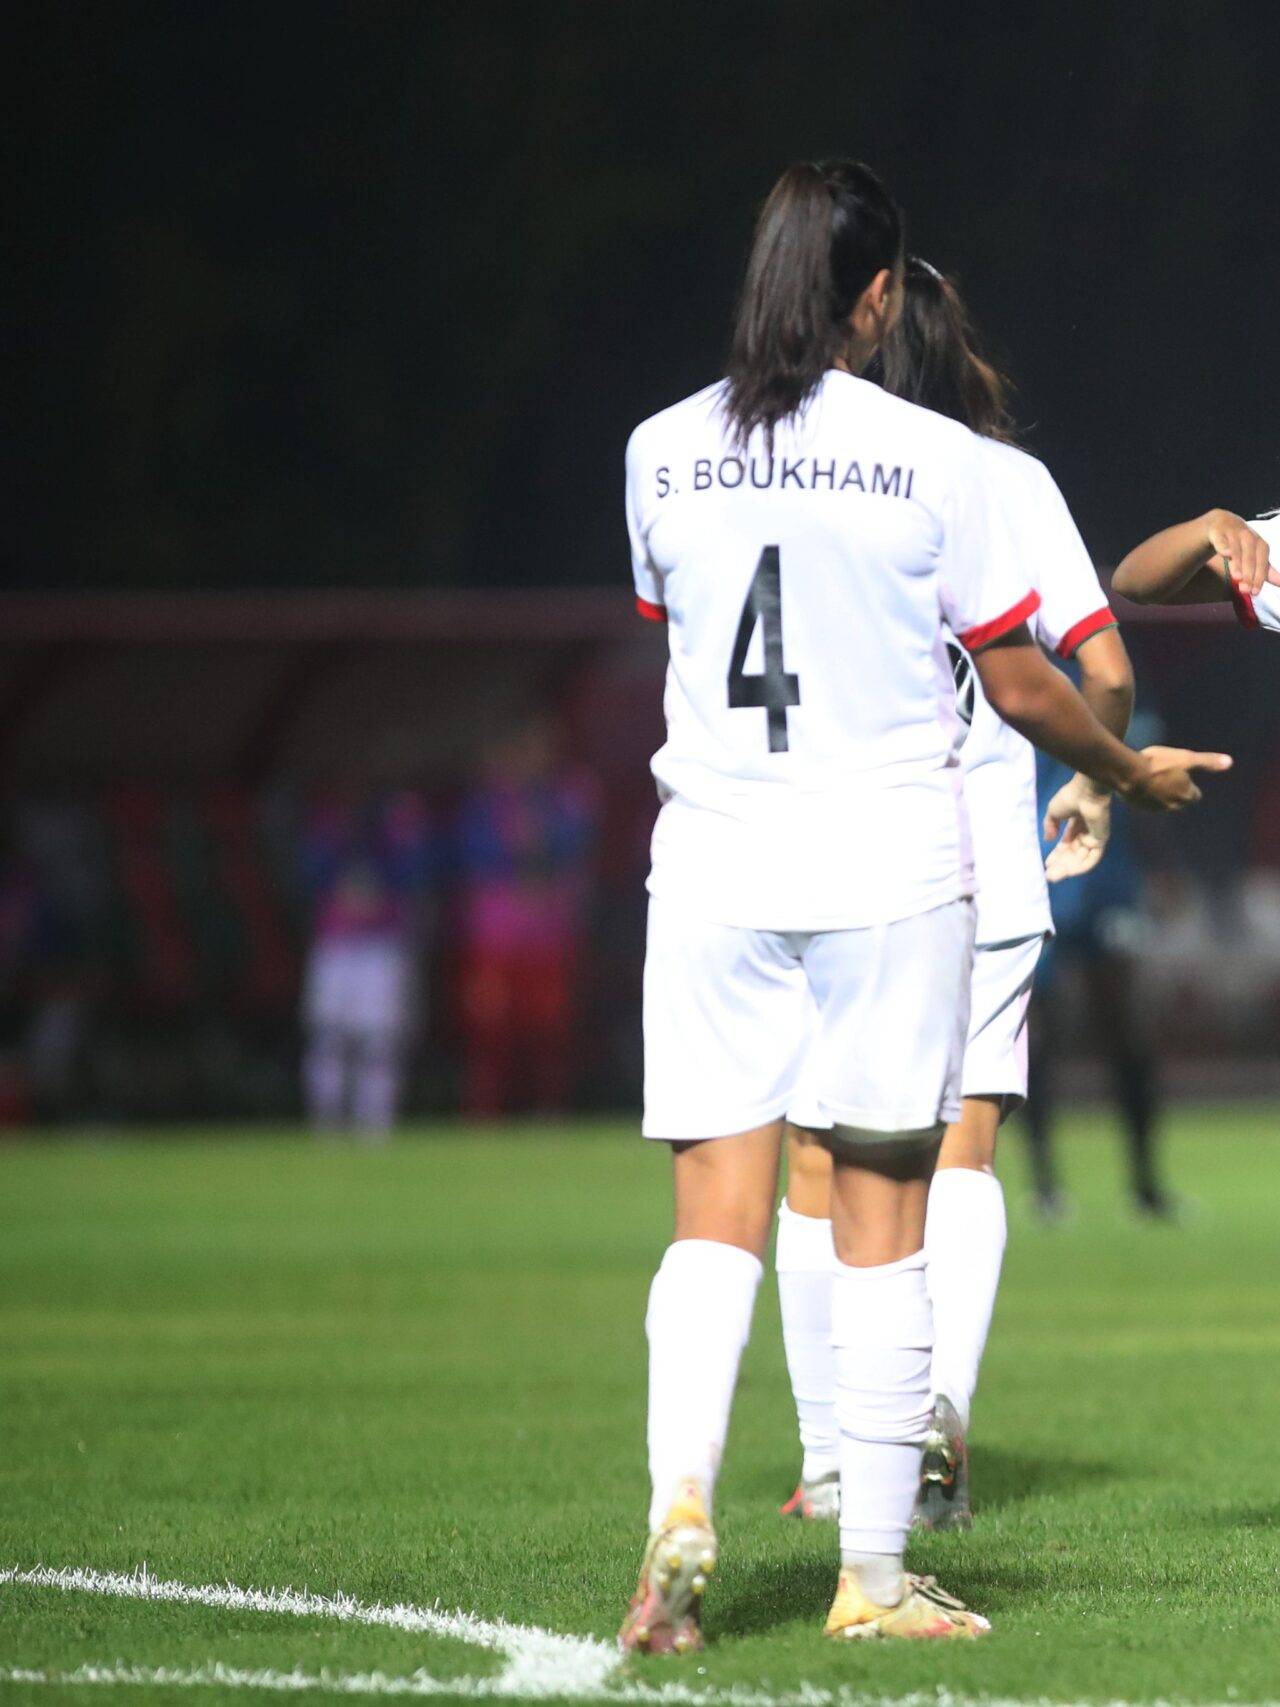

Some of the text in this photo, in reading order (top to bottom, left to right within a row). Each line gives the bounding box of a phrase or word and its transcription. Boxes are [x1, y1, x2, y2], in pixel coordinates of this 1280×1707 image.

[656, 456, 914, 499] S. BOUKHAMI
[727, 544, 801, 753] 4
